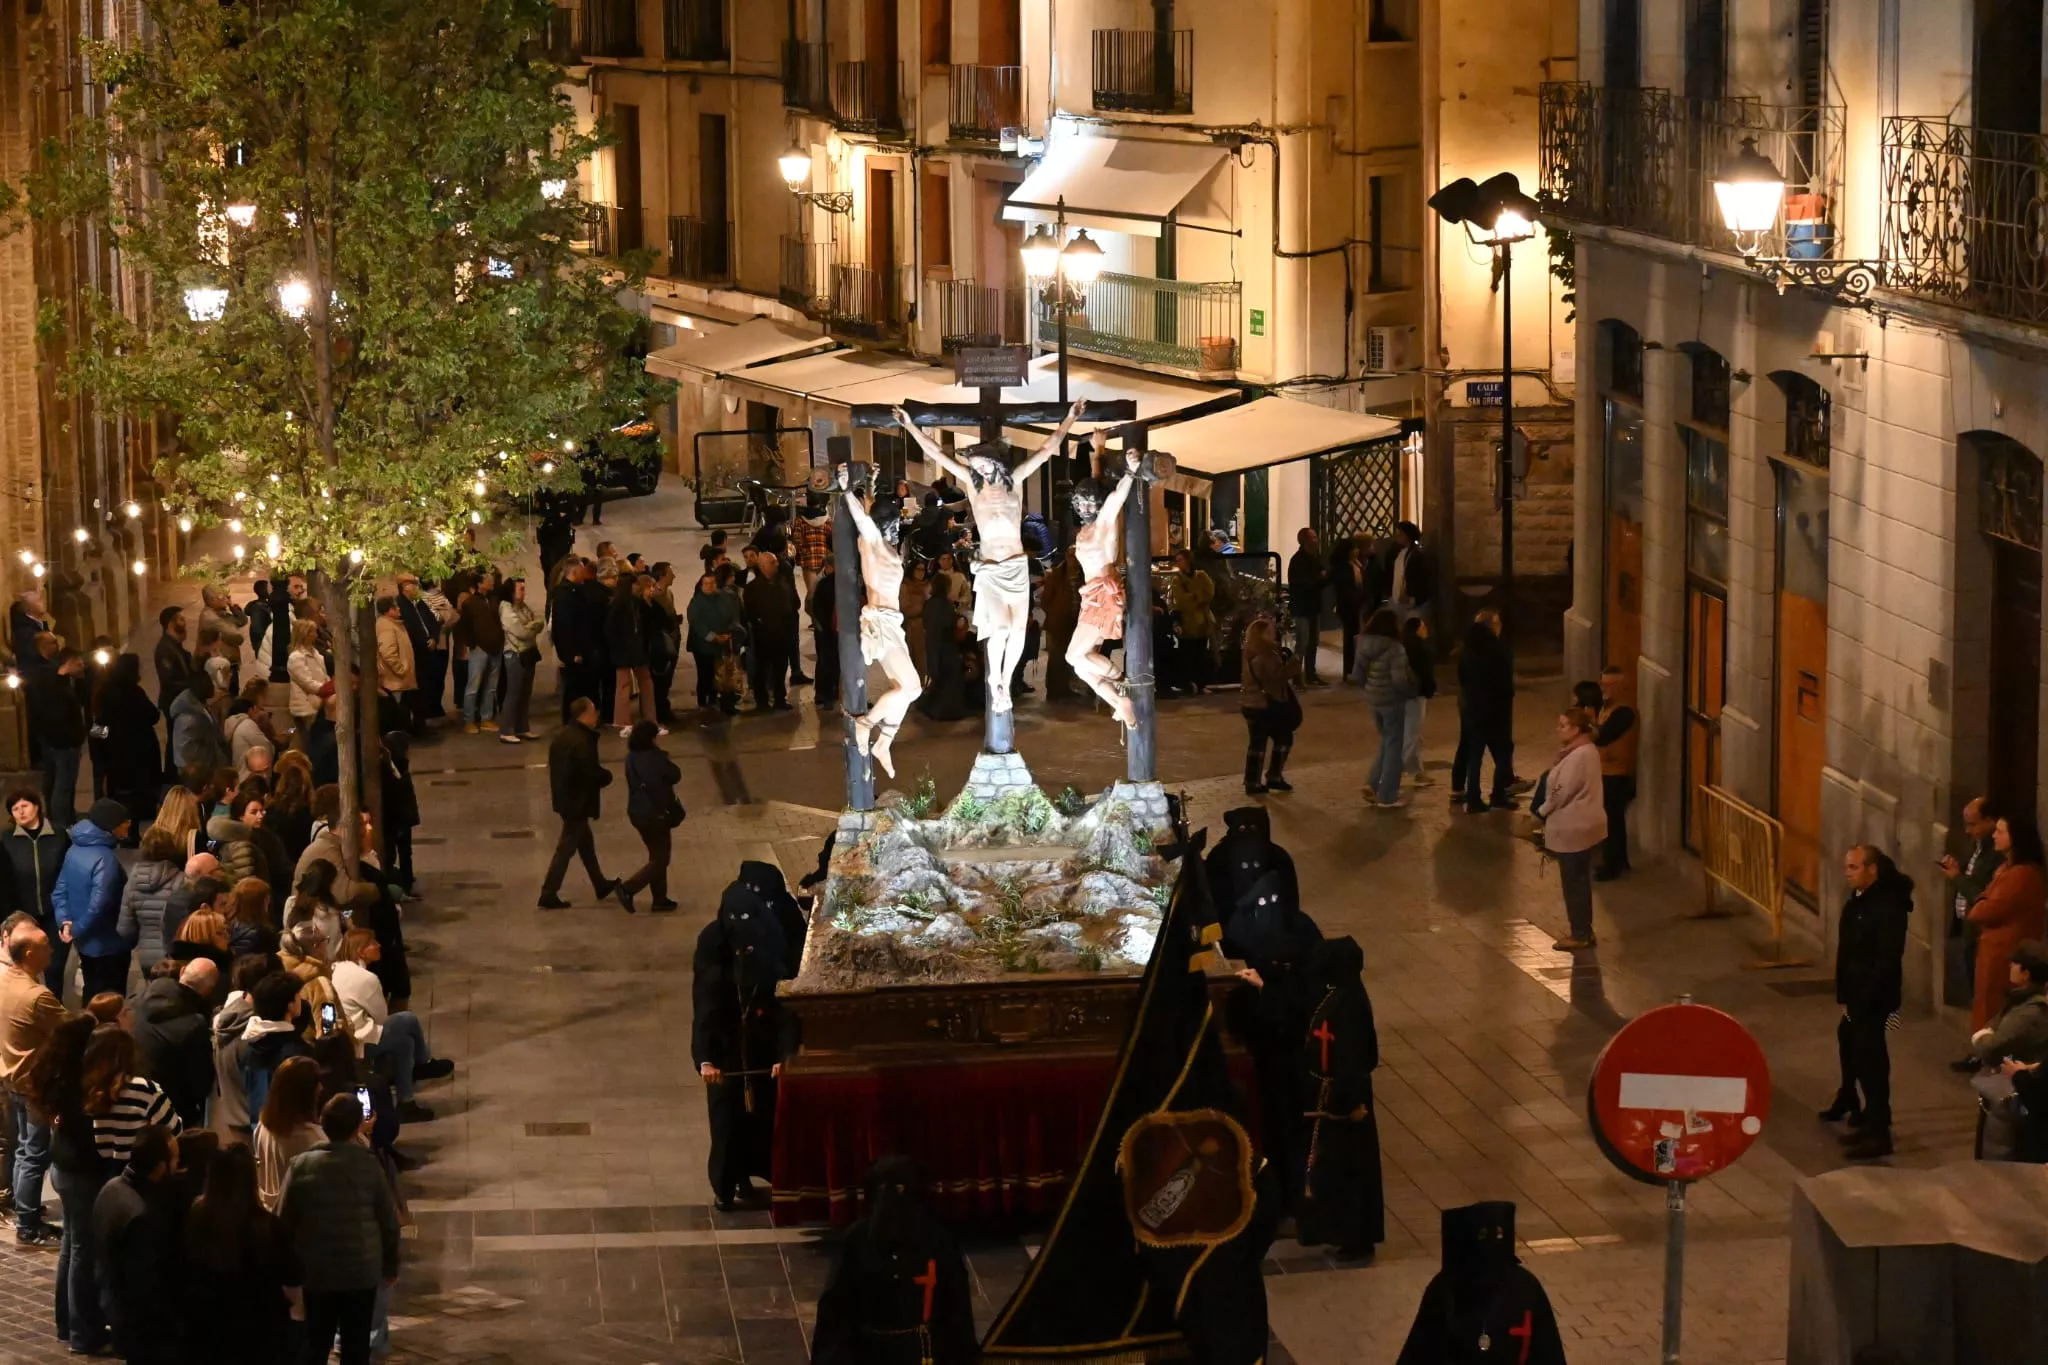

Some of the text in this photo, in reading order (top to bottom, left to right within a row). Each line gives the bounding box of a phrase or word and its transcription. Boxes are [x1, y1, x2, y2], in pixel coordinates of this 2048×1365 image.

[1477, 383, 1501, 392] CALLE
[1467, 396, 1504, 406] SAN ORENC
